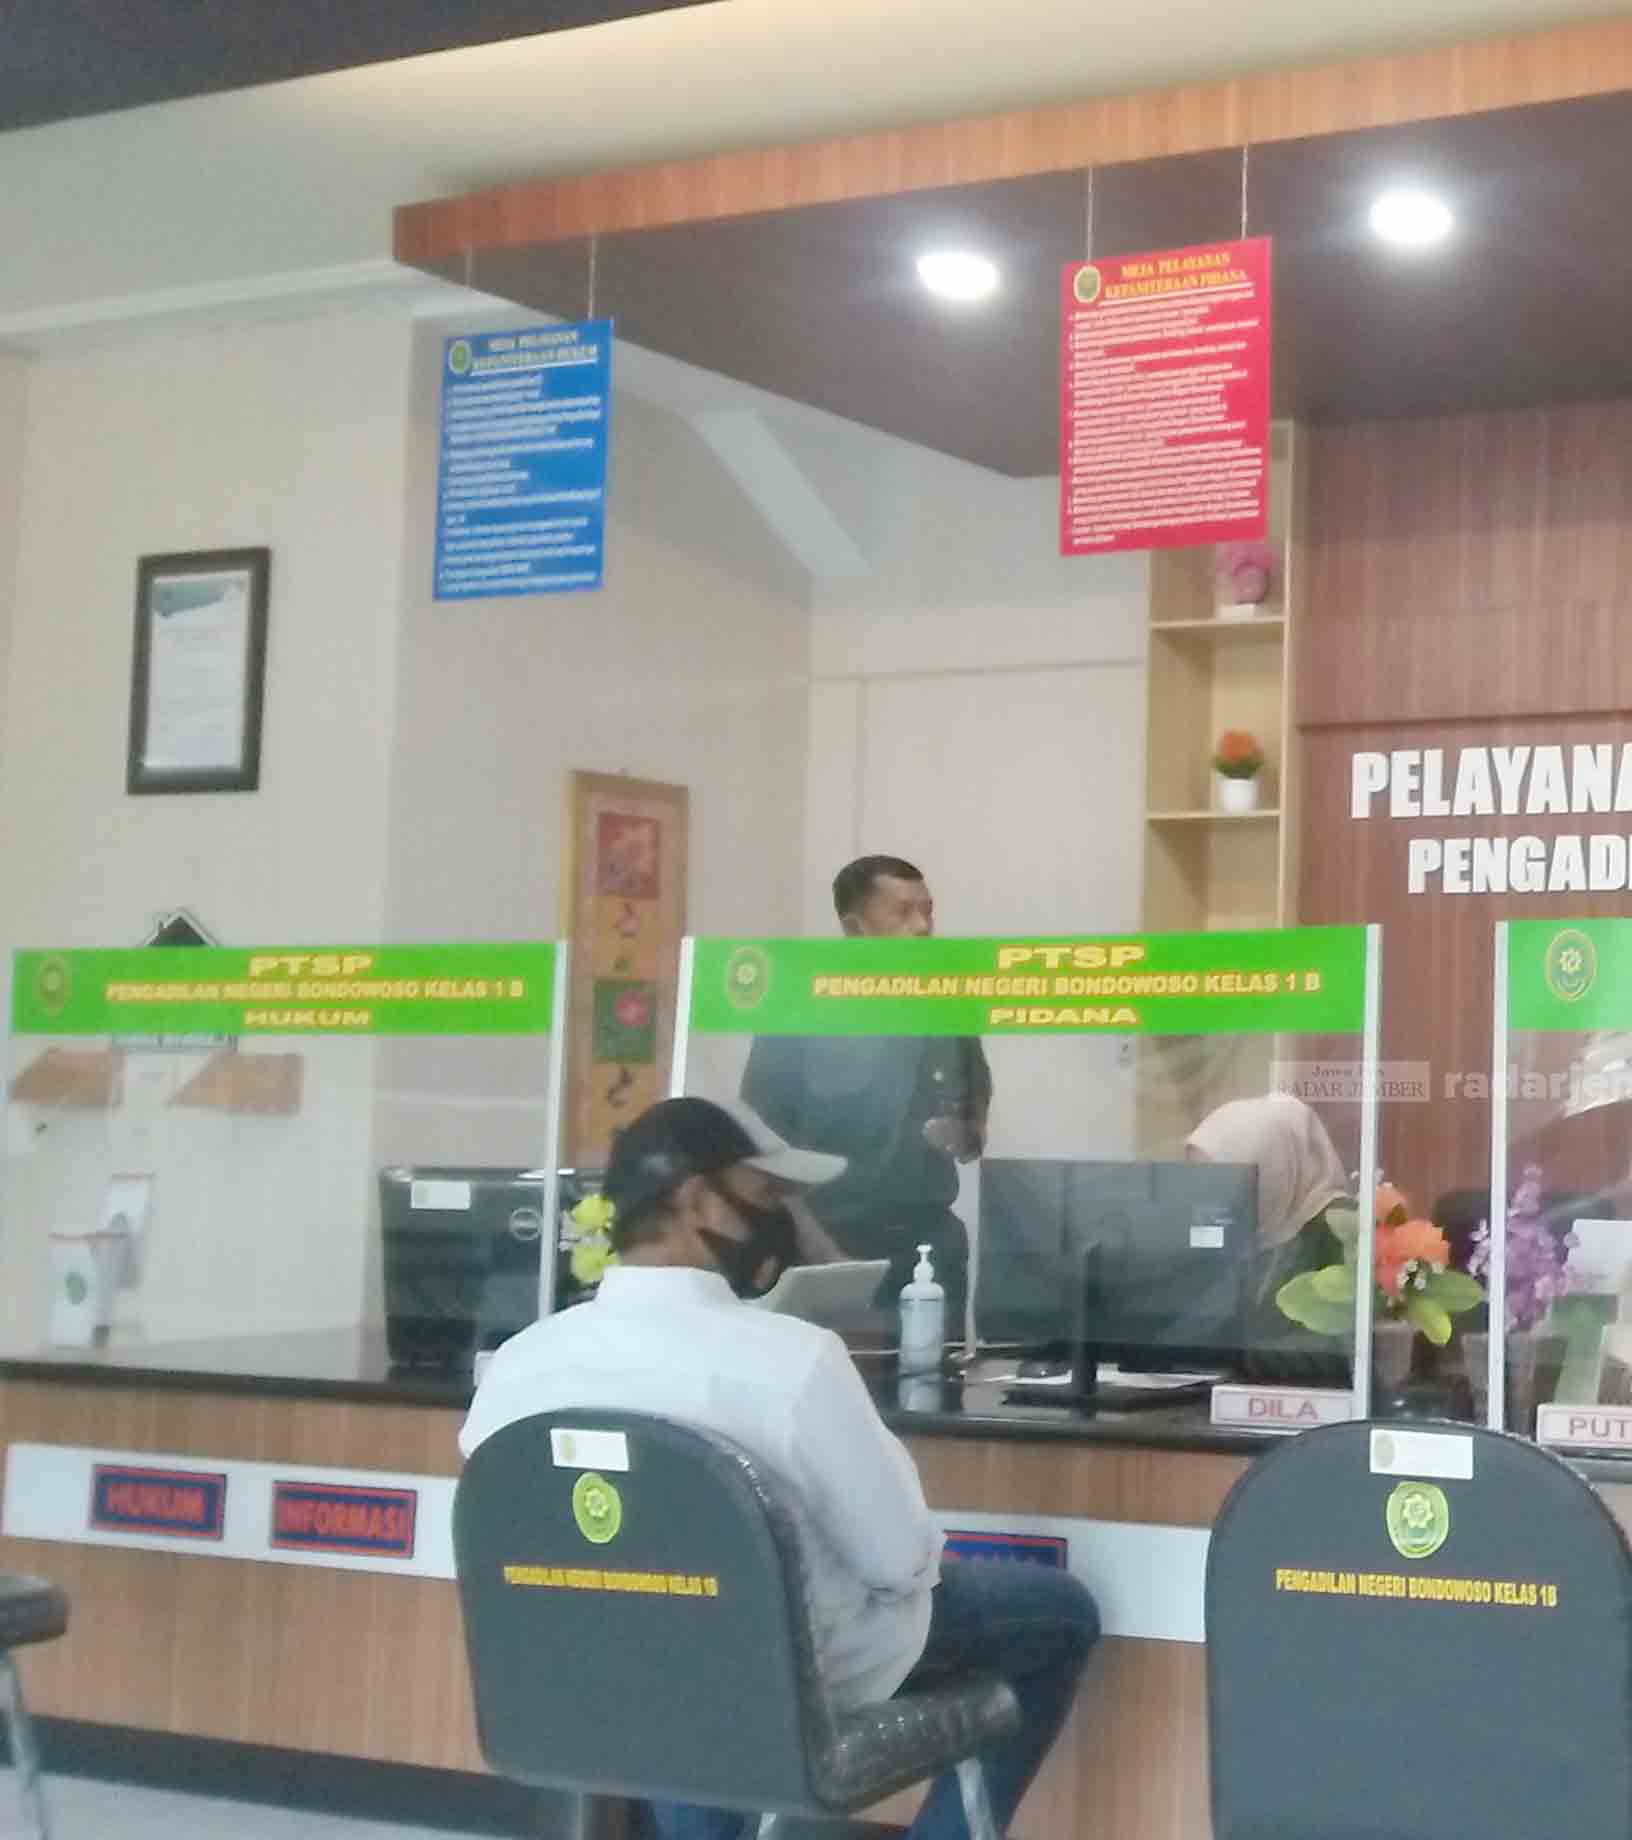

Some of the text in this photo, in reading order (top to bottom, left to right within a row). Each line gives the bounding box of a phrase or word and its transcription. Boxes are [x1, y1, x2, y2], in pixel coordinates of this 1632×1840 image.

[248, 955, 374, 978] PTSP
[997, 945, 1146, 969] PTSP
[425, 981, 486, 999] KELAS
[813, 970, 1322, 997] PENGADILAN NEGERI BONDOWOSO KELAS 1 B
[988, 1007, 1138, 1025] PIDANA
[1248, 1396, 1319, 1421] DILA
[1275, 1569, 1355, 1595] PENGADILAN
[1358, 1574, 1405, 1597] NEGERI
[1408, 1577, 1490, 1603] BONDOWOSO
[1493, 1583, 1536, 1606] KELAS
